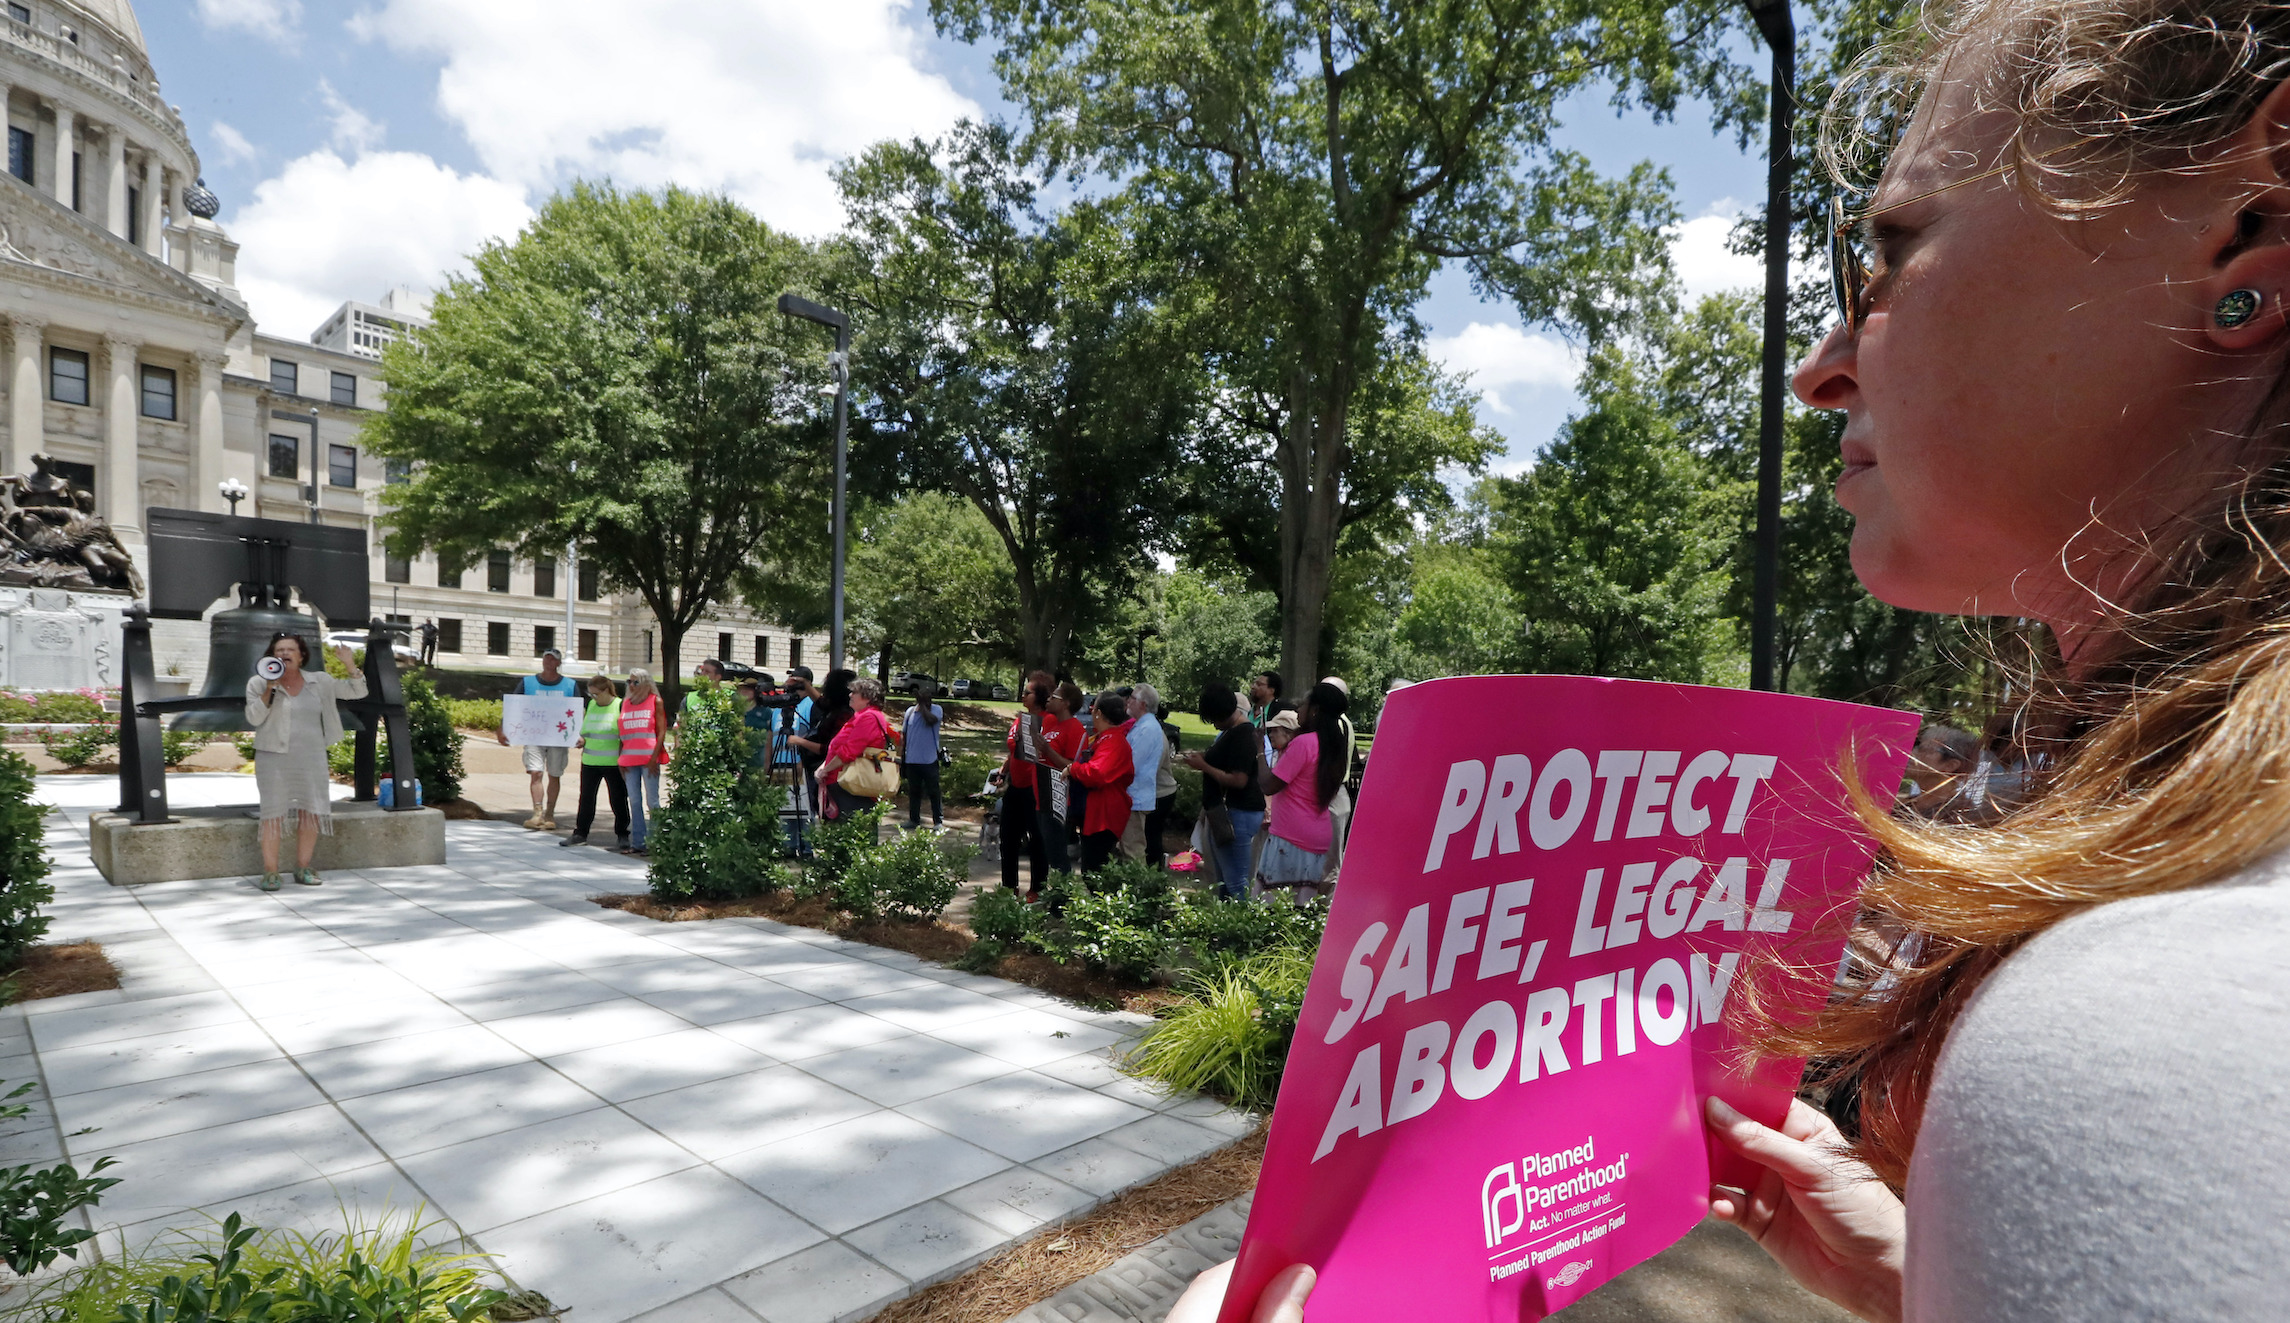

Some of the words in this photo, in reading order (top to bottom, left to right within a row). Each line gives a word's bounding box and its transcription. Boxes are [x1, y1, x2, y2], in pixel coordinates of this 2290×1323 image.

[521, 707, 548, 723] SAFE
[1422, 748, 1778, 874] PROTECT
[1324, 877, 1549, 1046] SAFE,
[1569, 857, 1794, 958] LEGAL
[1310, 951, 1742, 1165] ABORTION
[1522, 1135, 1595, 1183] Planned
[1525, 1153, 1627, 1214] Parenthood
[1529, 1216, 1550, 1234] Act.
[1551, 1210, 1564, 1225] No
[1564, 1199, 1592, 1220] matter
[1592, 1191, 1613, 1209] what.
[1489, 1253, 1530, 1283] Planned
[1530, 1232, 1581, 1267] Parenthood
[1581, 1223, 1608, 1245] Action
[1608, 1211, 1627, 1233] Fund
[1585, 1258, 1594, 1271] 21
